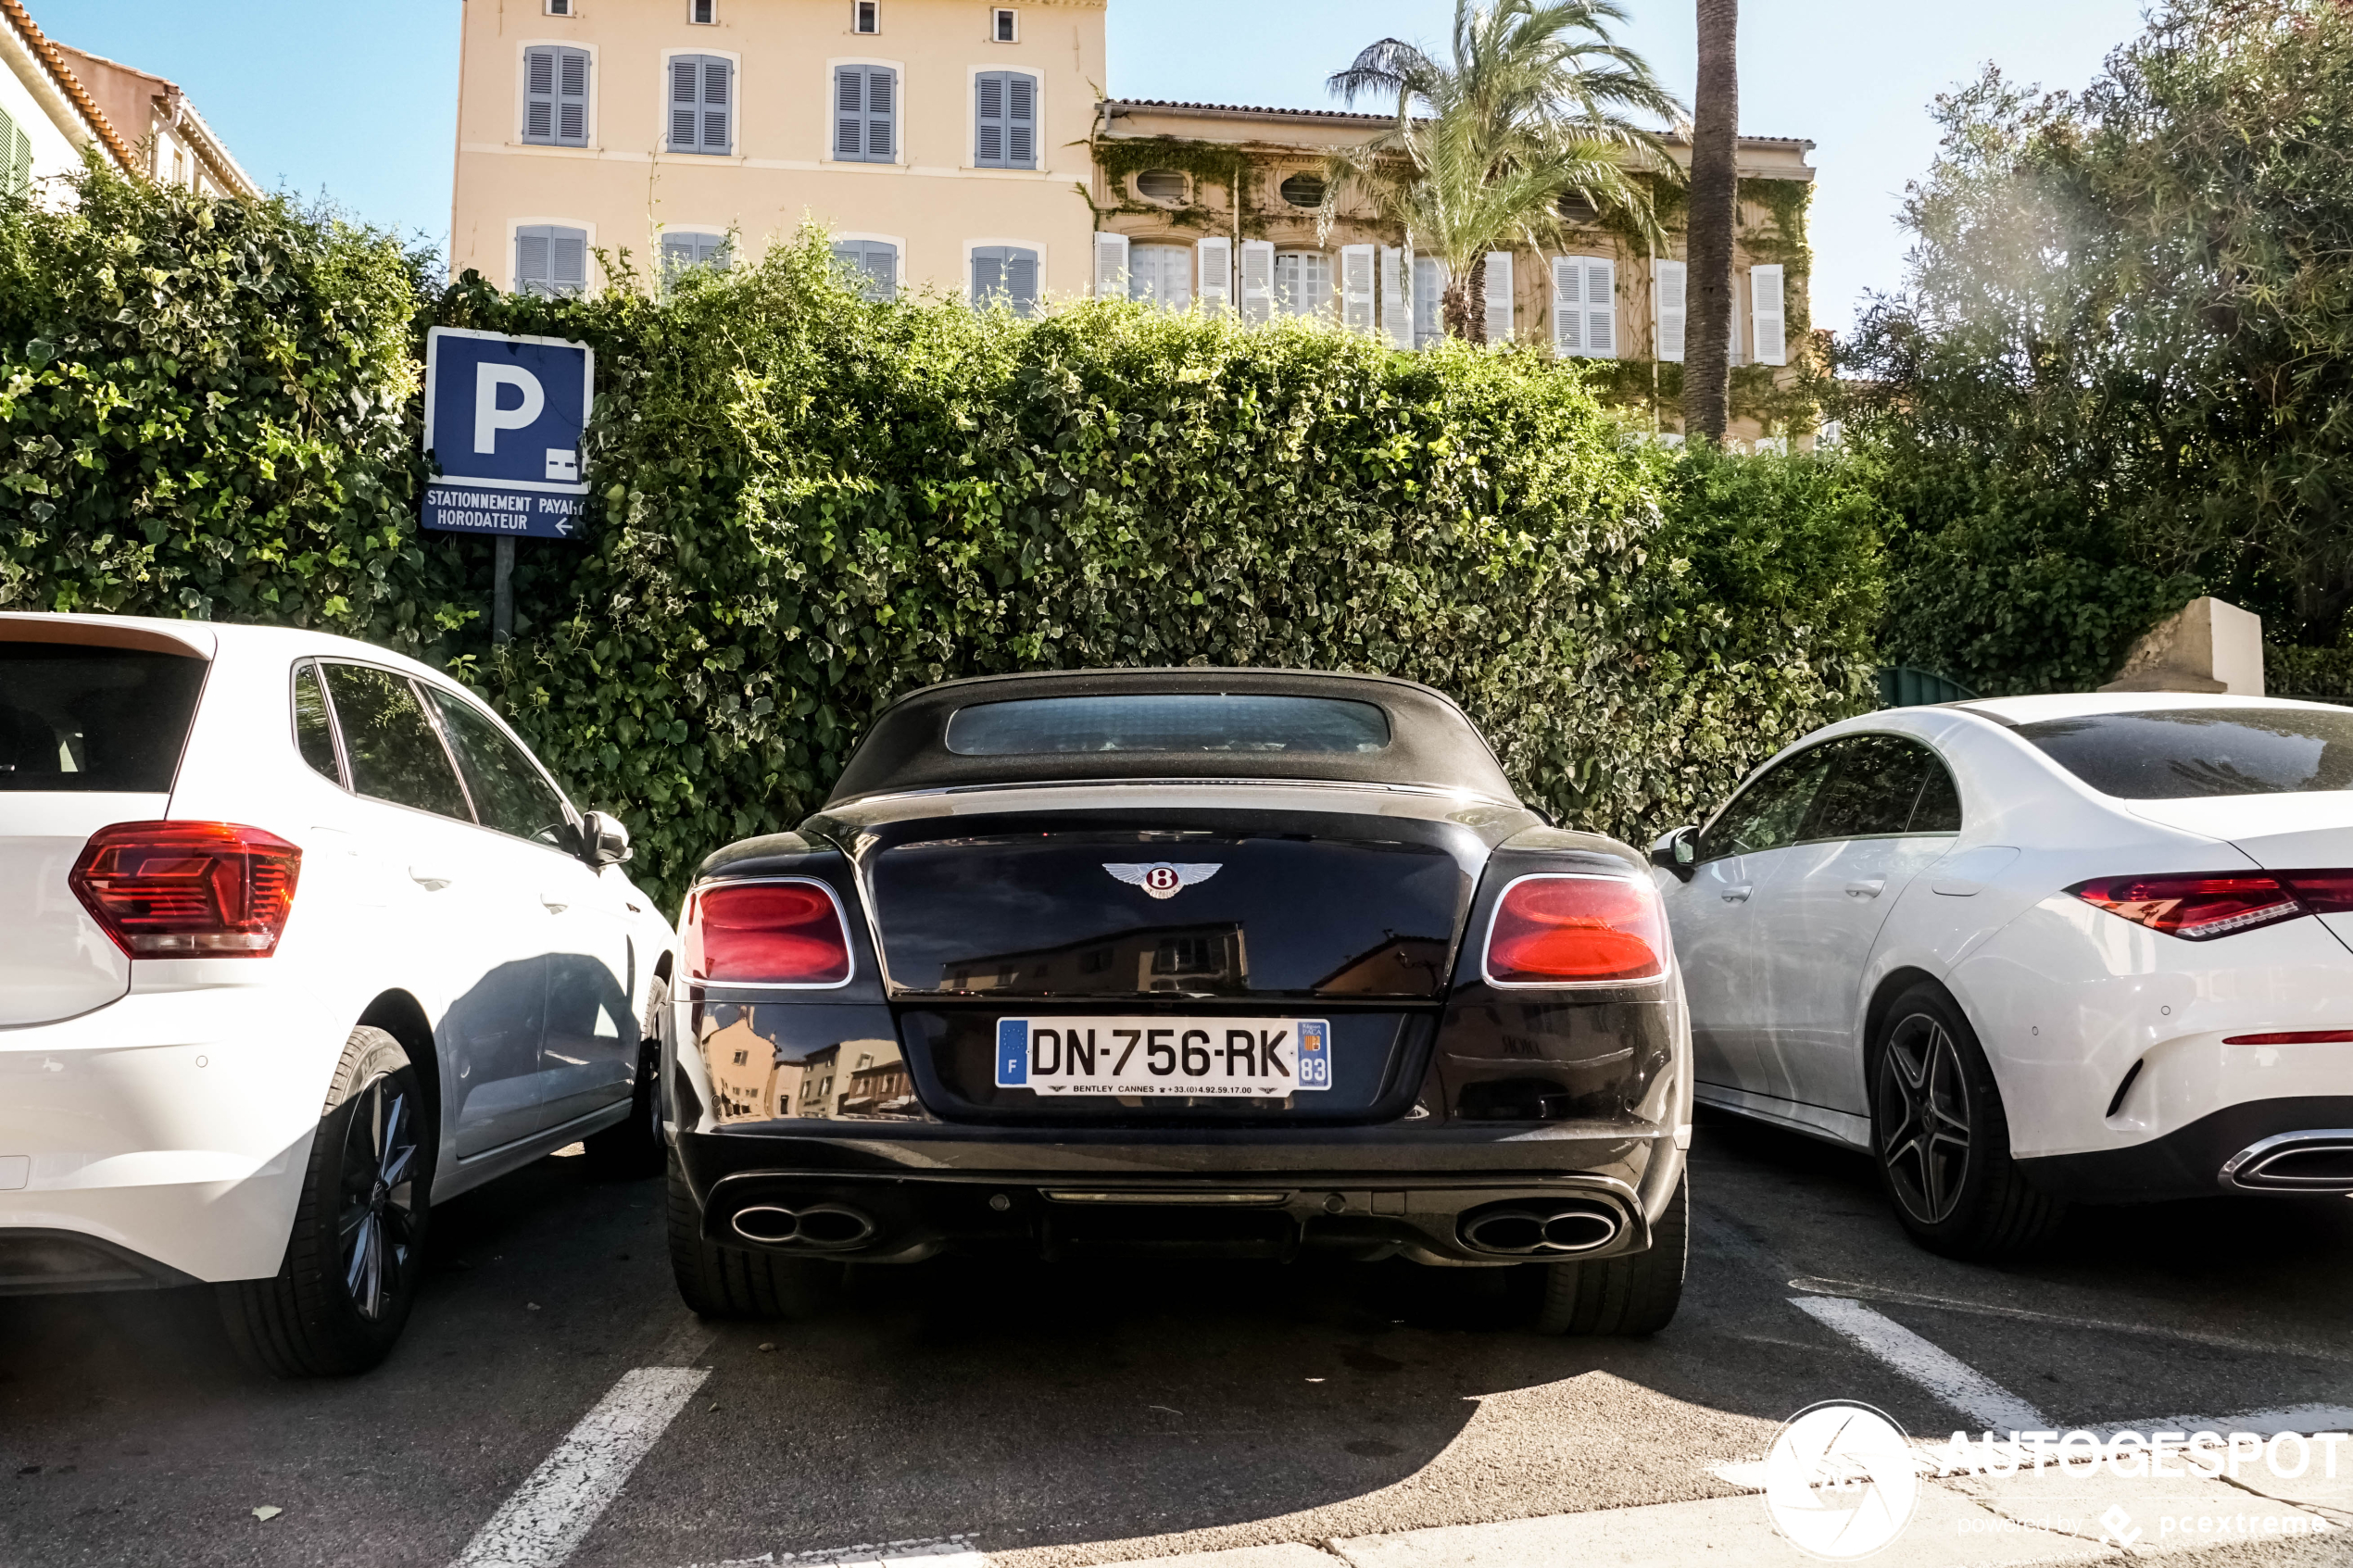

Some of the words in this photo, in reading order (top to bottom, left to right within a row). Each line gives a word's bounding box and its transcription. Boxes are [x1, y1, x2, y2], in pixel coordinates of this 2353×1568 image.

[473, 361, 545, 454] P
[427, 490, 532, 512] STATIONNEMENT
[437, 509, 528, 530] HORODATEUR
[1151, 869, 1173, 888] B
[1032, 1029, 1290, 1077] DN-756-RK
[1008, 1060, 1017, 1073] F
[1301, 1058, 1326, 1081] 83
[1073, 1085, 1114, 1093] BENTLEY
